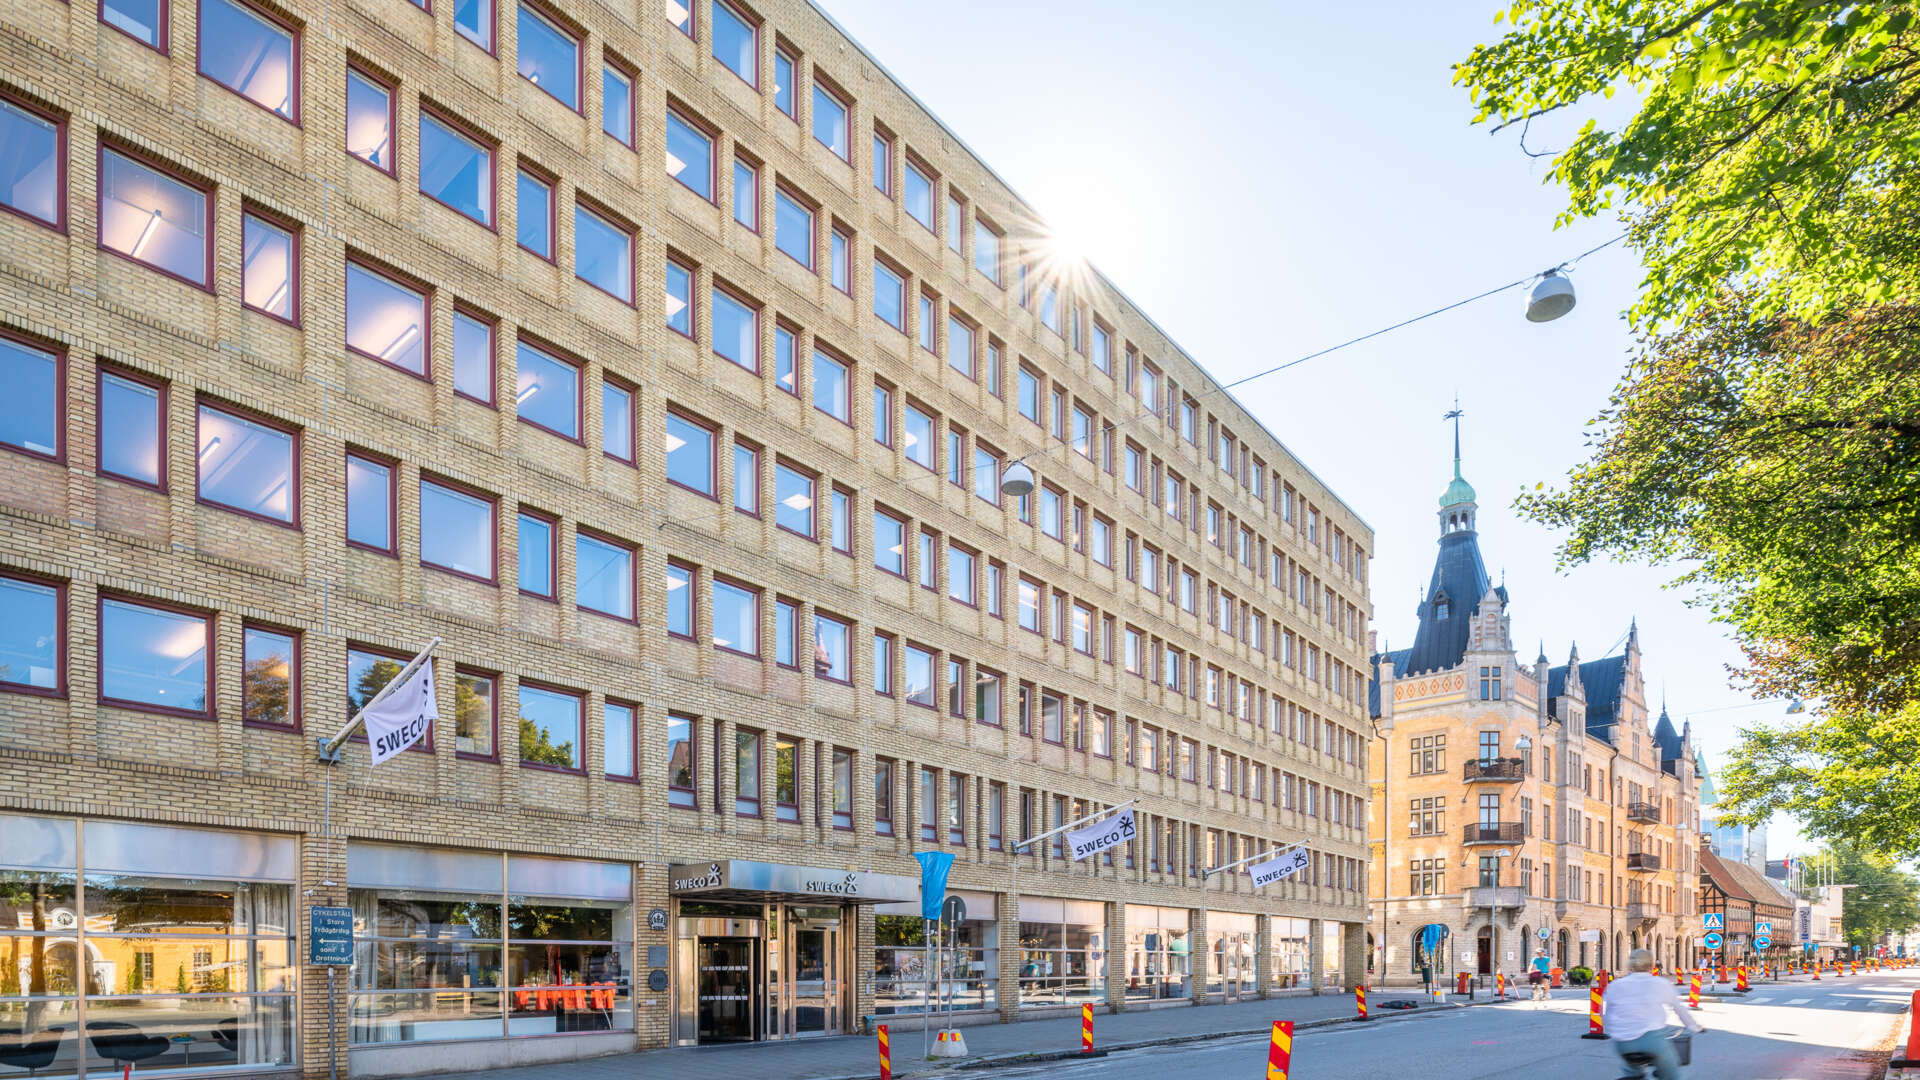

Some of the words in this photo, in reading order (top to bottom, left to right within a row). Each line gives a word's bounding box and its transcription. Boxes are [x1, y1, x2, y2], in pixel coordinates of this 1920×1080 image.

[376, 713, 424, 757] SWECO
[1076, 832, 1119, 856] SWECO
[674, 877, 706, 890] SWECO
[1256, 866, 1292, 885] SWECO
[806, 880, 842, 893] SWECO
